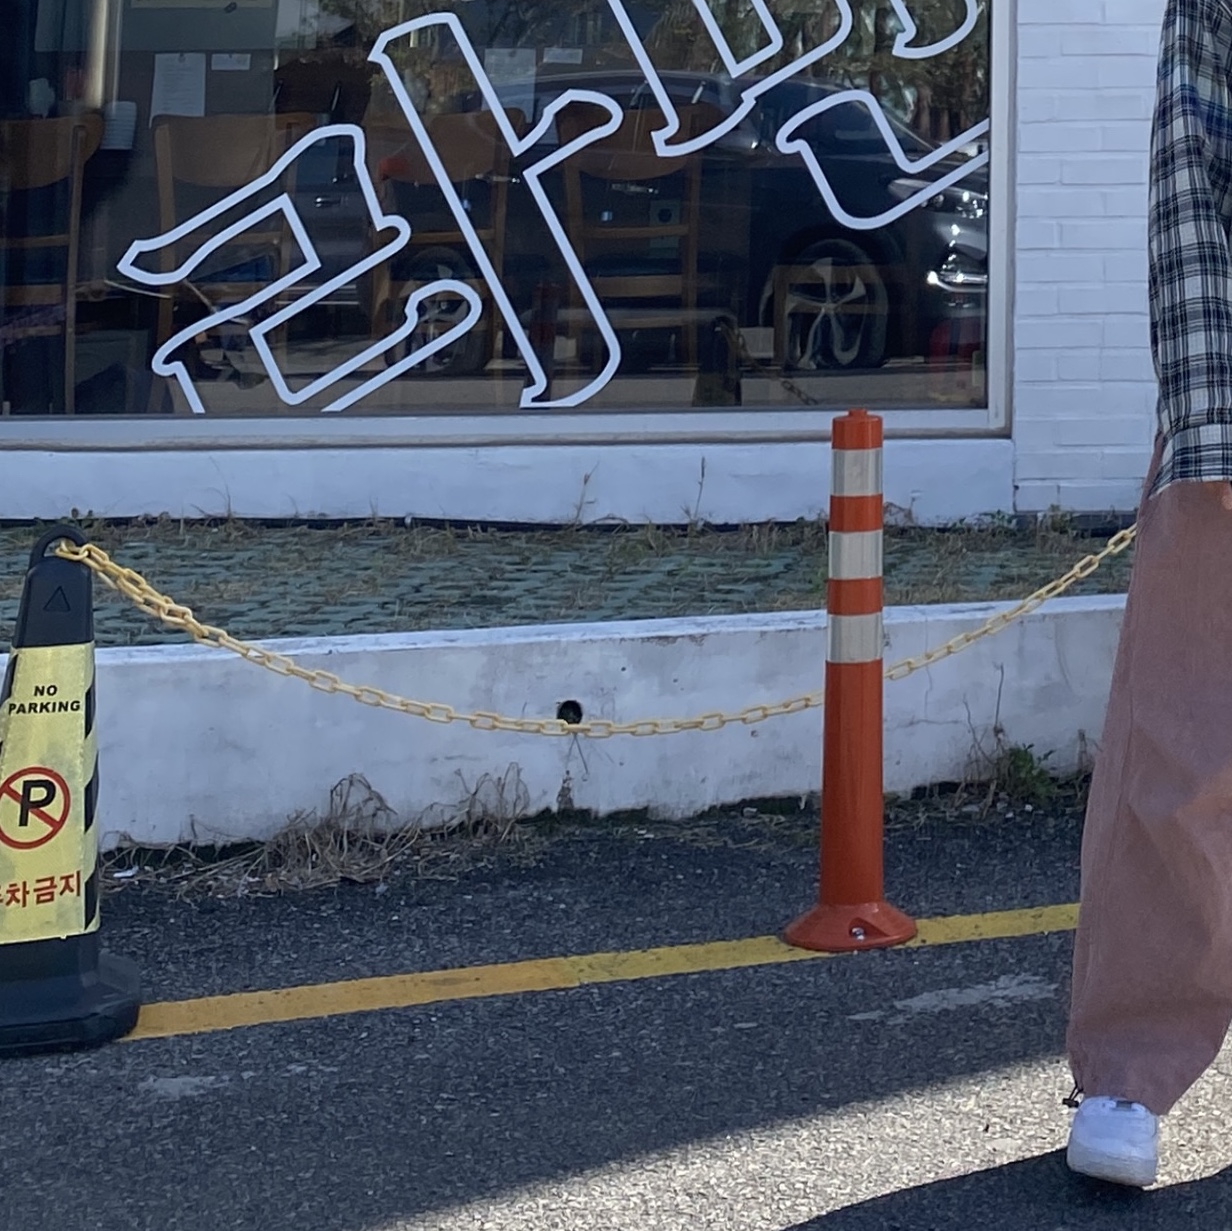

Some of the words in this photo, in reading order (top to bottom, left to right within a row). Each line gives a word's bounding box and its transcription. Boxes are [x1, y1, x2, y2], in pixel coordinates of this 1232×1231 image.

[33, 684, 58, 696] NO
[8, 700, 81, 716] PARKING
[0, 870, 81, 908] 차금지
